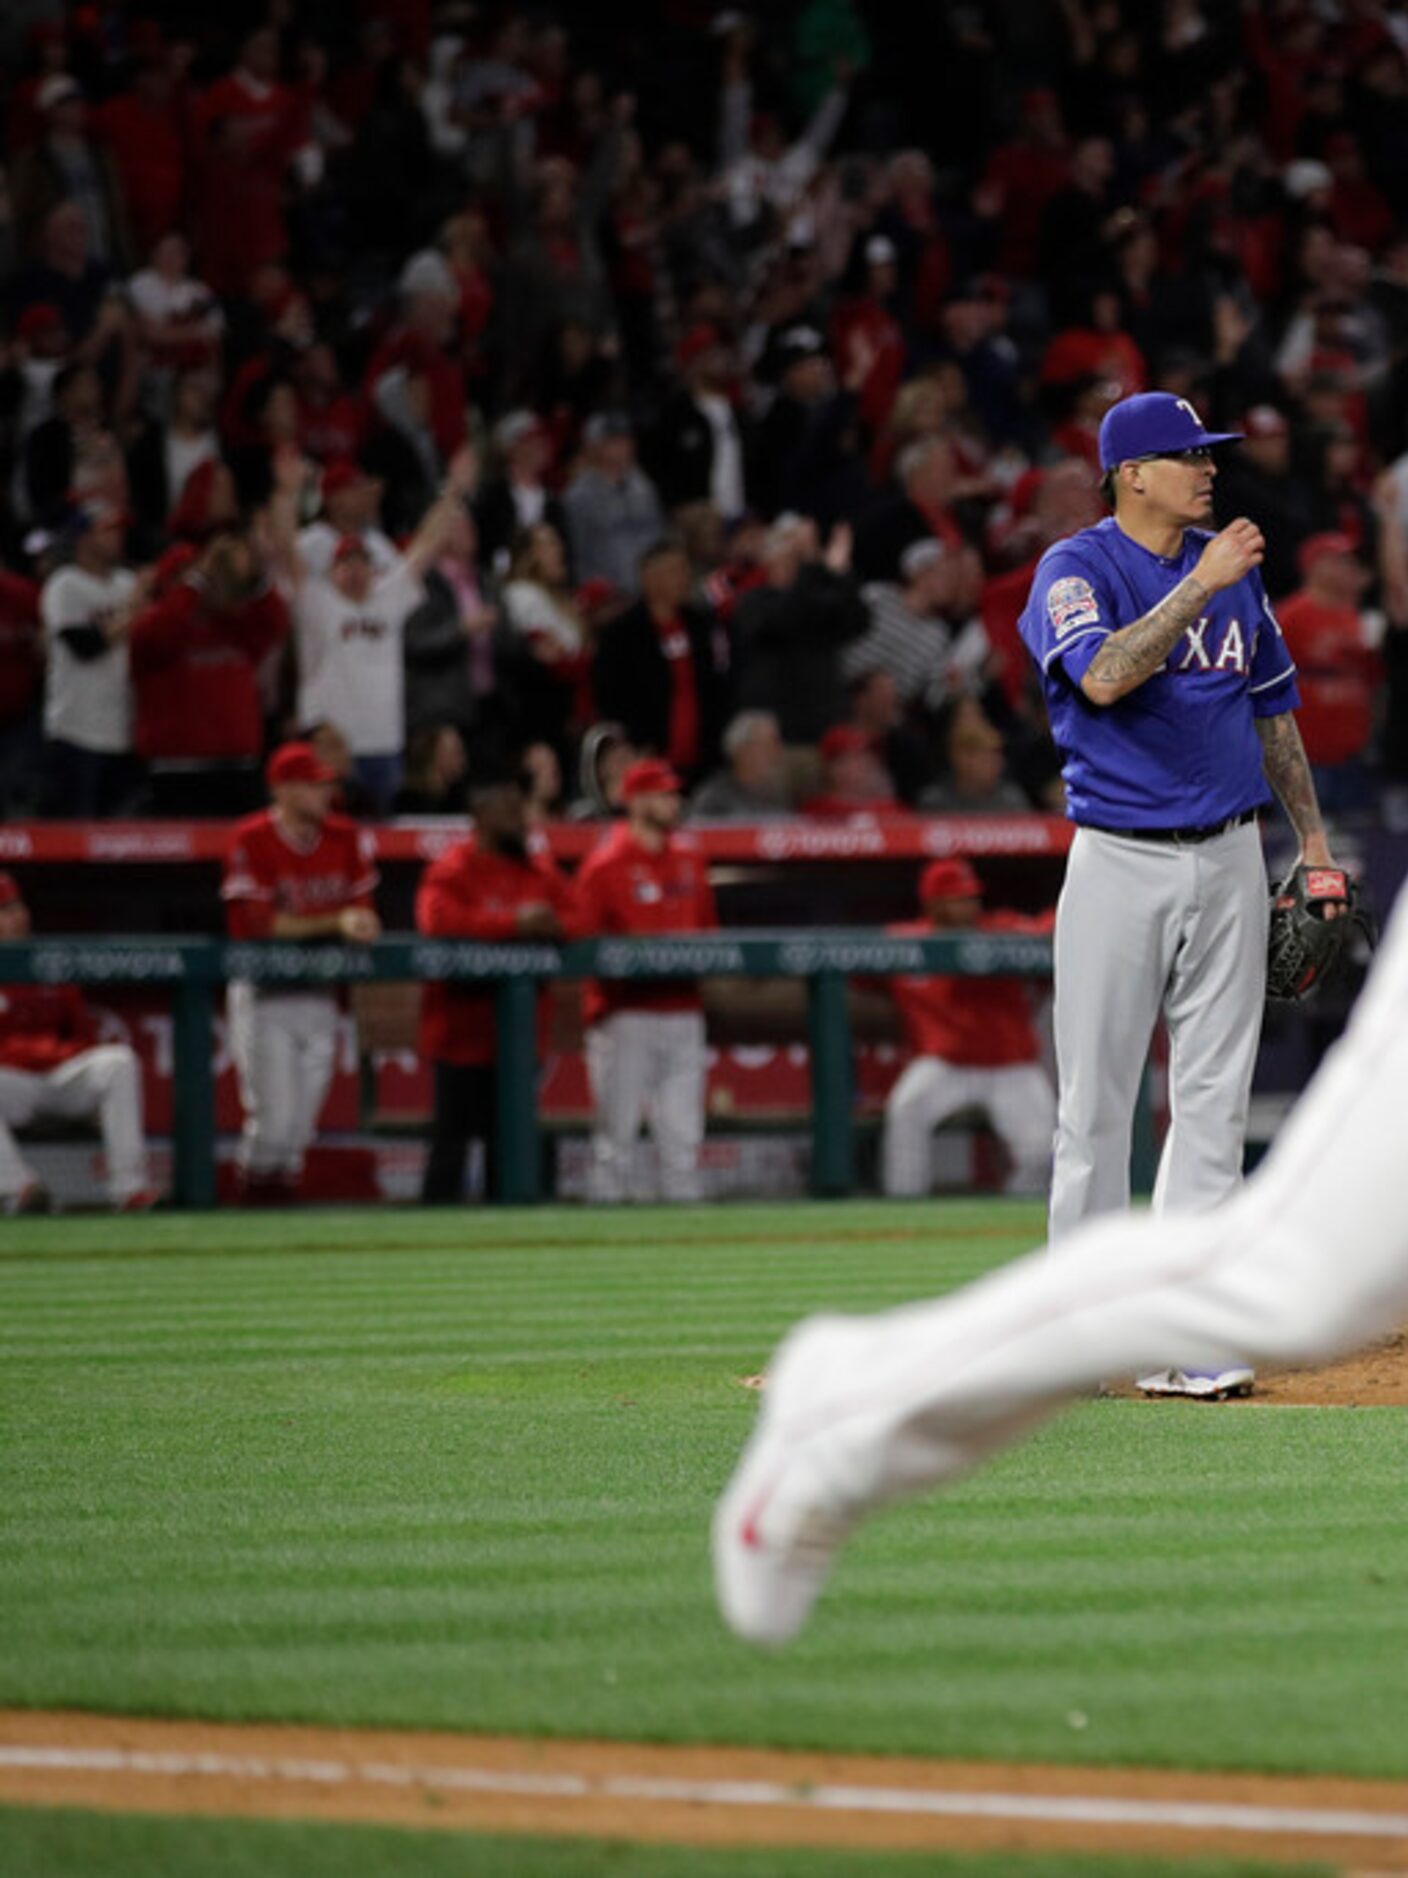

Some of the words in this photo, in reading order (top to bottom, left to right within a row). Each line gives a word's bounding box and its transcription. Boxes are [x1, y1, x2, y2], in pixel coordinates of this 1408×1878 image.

[1176, 398, 1203, 427] T
[1162, 617, 1256, 674] XA
[791, 828, 885, 853] TOYOTA
[962, 824, 1051, 850] TOYOTA
[77, 948, 185, 978] TOYOTA
[457, 945, 561, 975] TOYOTA
[638, 943, 743, 974] TOYOTA
[819, 943, 925, 970] TOYOTA
